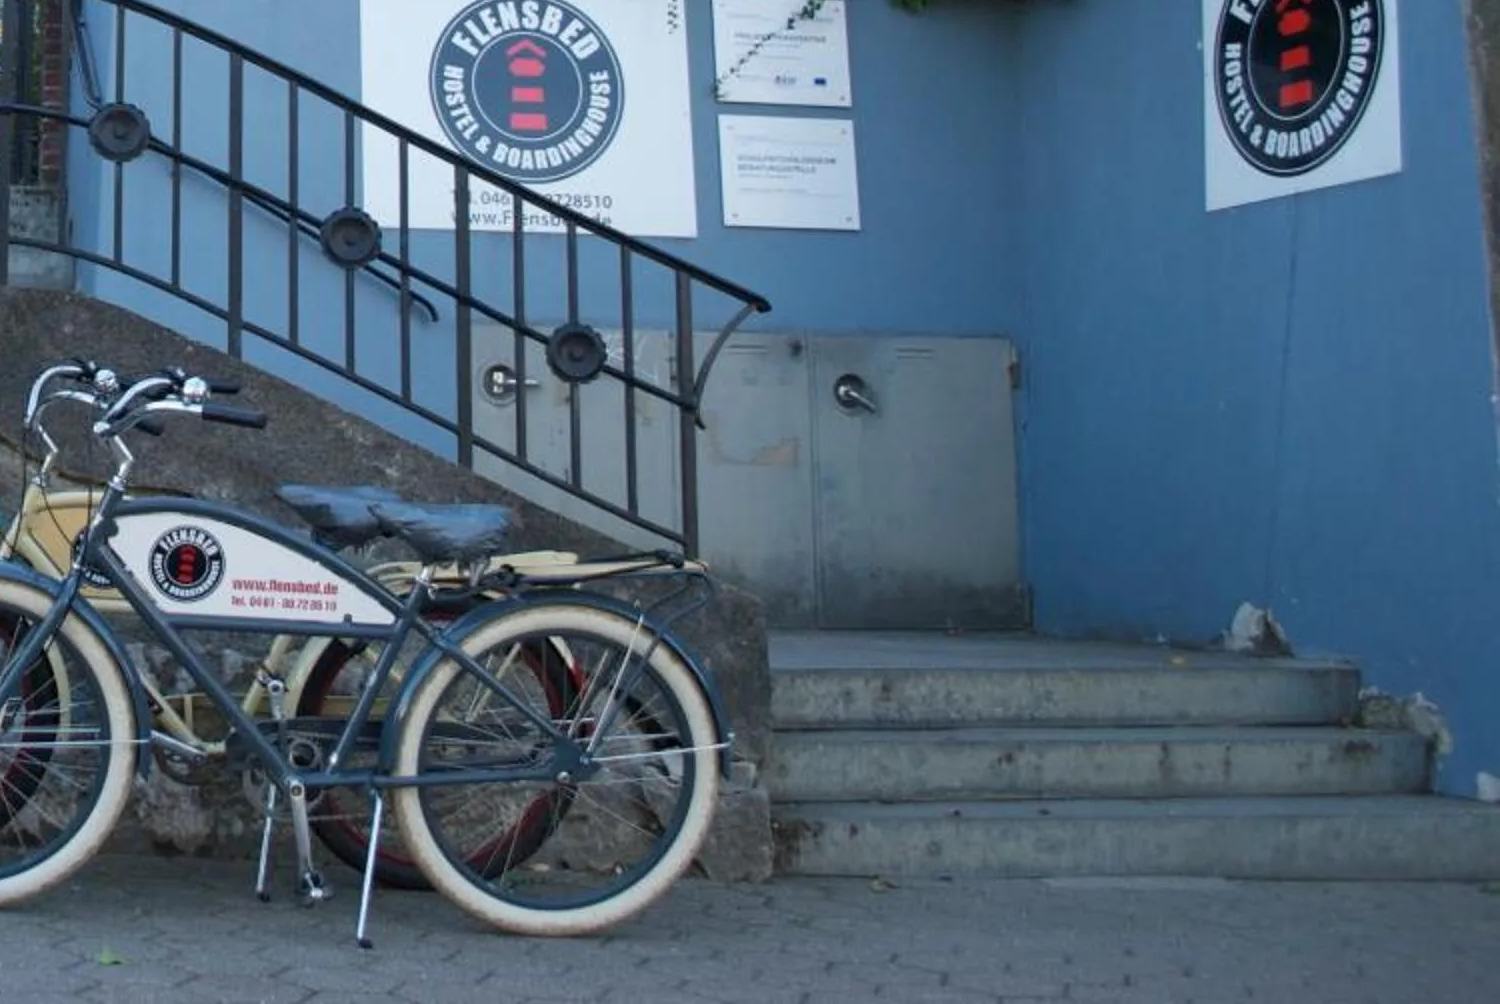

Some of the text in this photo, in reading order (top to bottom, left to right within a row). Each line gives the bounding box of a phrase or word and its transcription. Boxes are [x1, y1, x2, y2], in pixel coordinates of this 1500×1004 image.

[451, 0, 600, 60] FLENSBED
[1224, 0, 1372, 158] HOSTEL & BOARDINGHOUSE
[444, 65, 611, 171] HOSTEL & BOARDINGHOUSE
[159, 529, 218, 556] FLENSBED
[232, 580, 338, 595] www.flensbed.de
